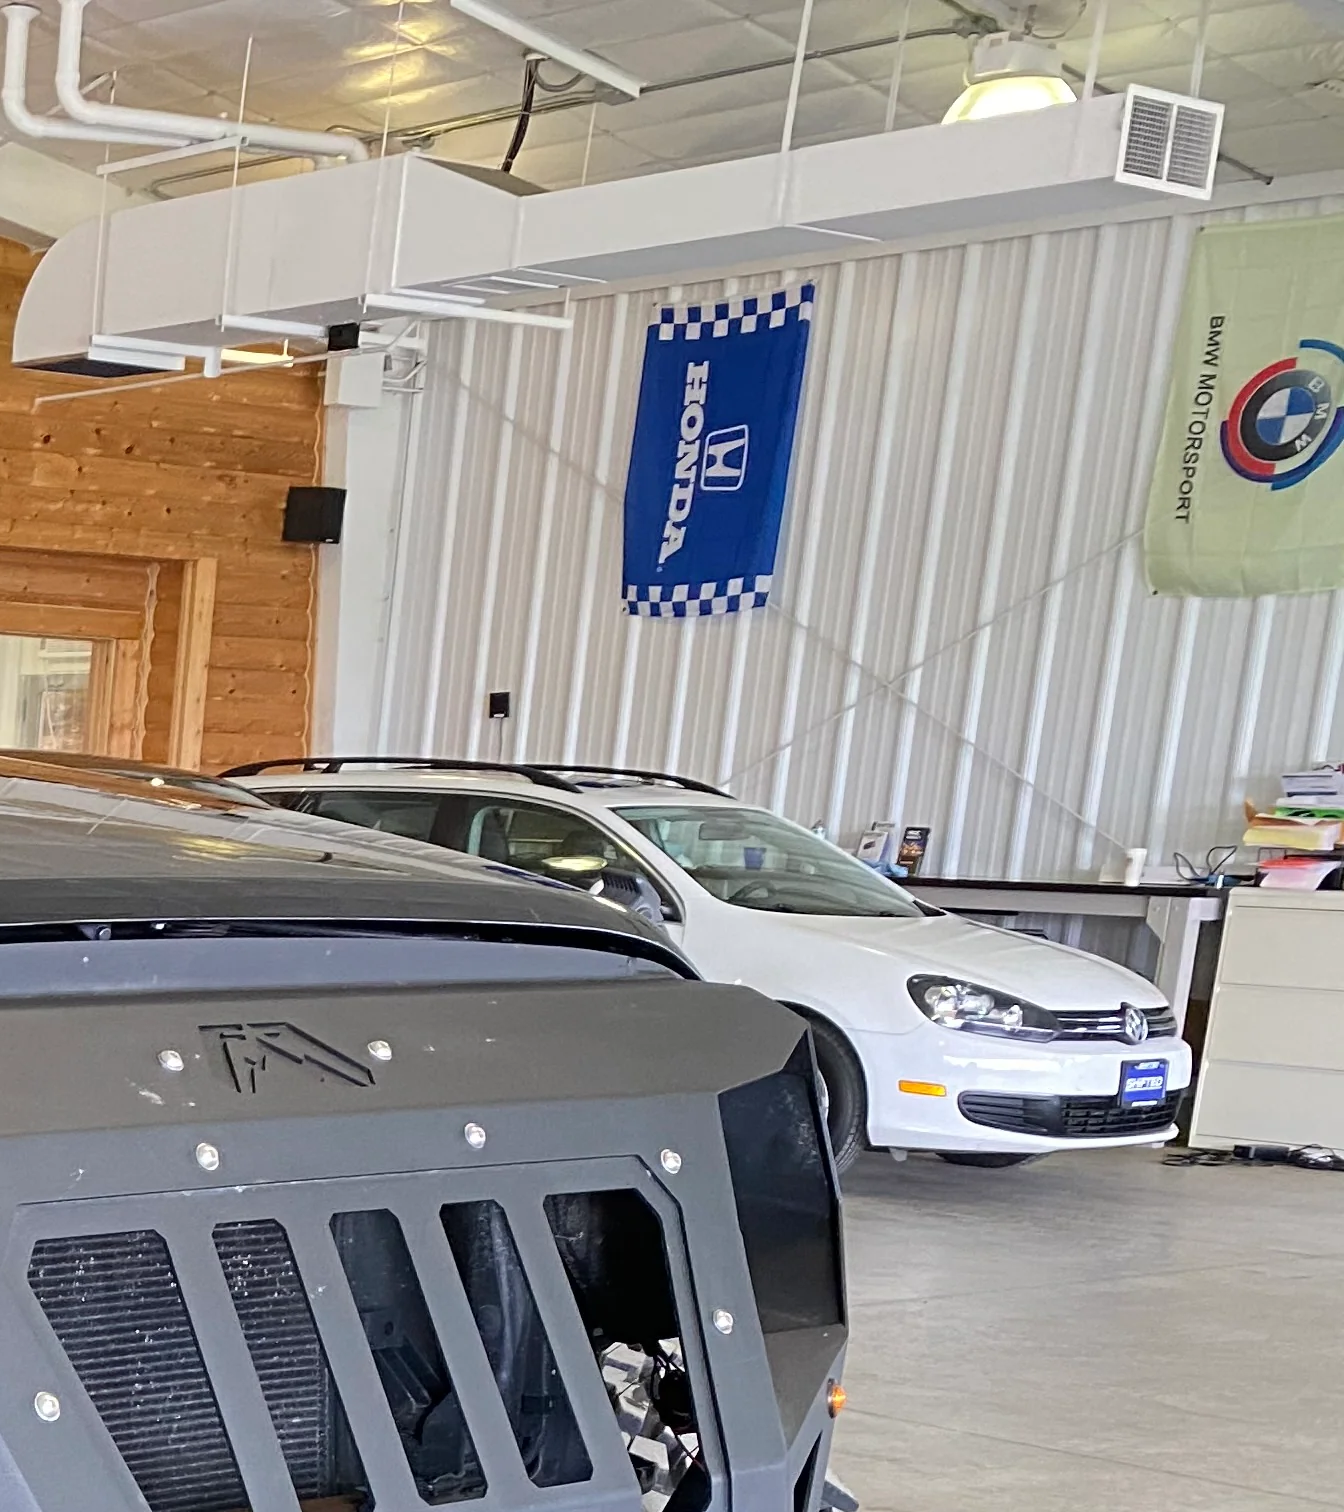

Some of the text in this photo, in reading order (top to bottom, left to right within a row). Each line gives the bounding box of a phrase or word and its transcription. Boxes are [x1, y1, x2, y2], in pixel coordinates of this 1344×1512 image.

[658, 360, 710, 564] HONDA
[1175, 316, 1225, 524] BMW MOTORSPORT
